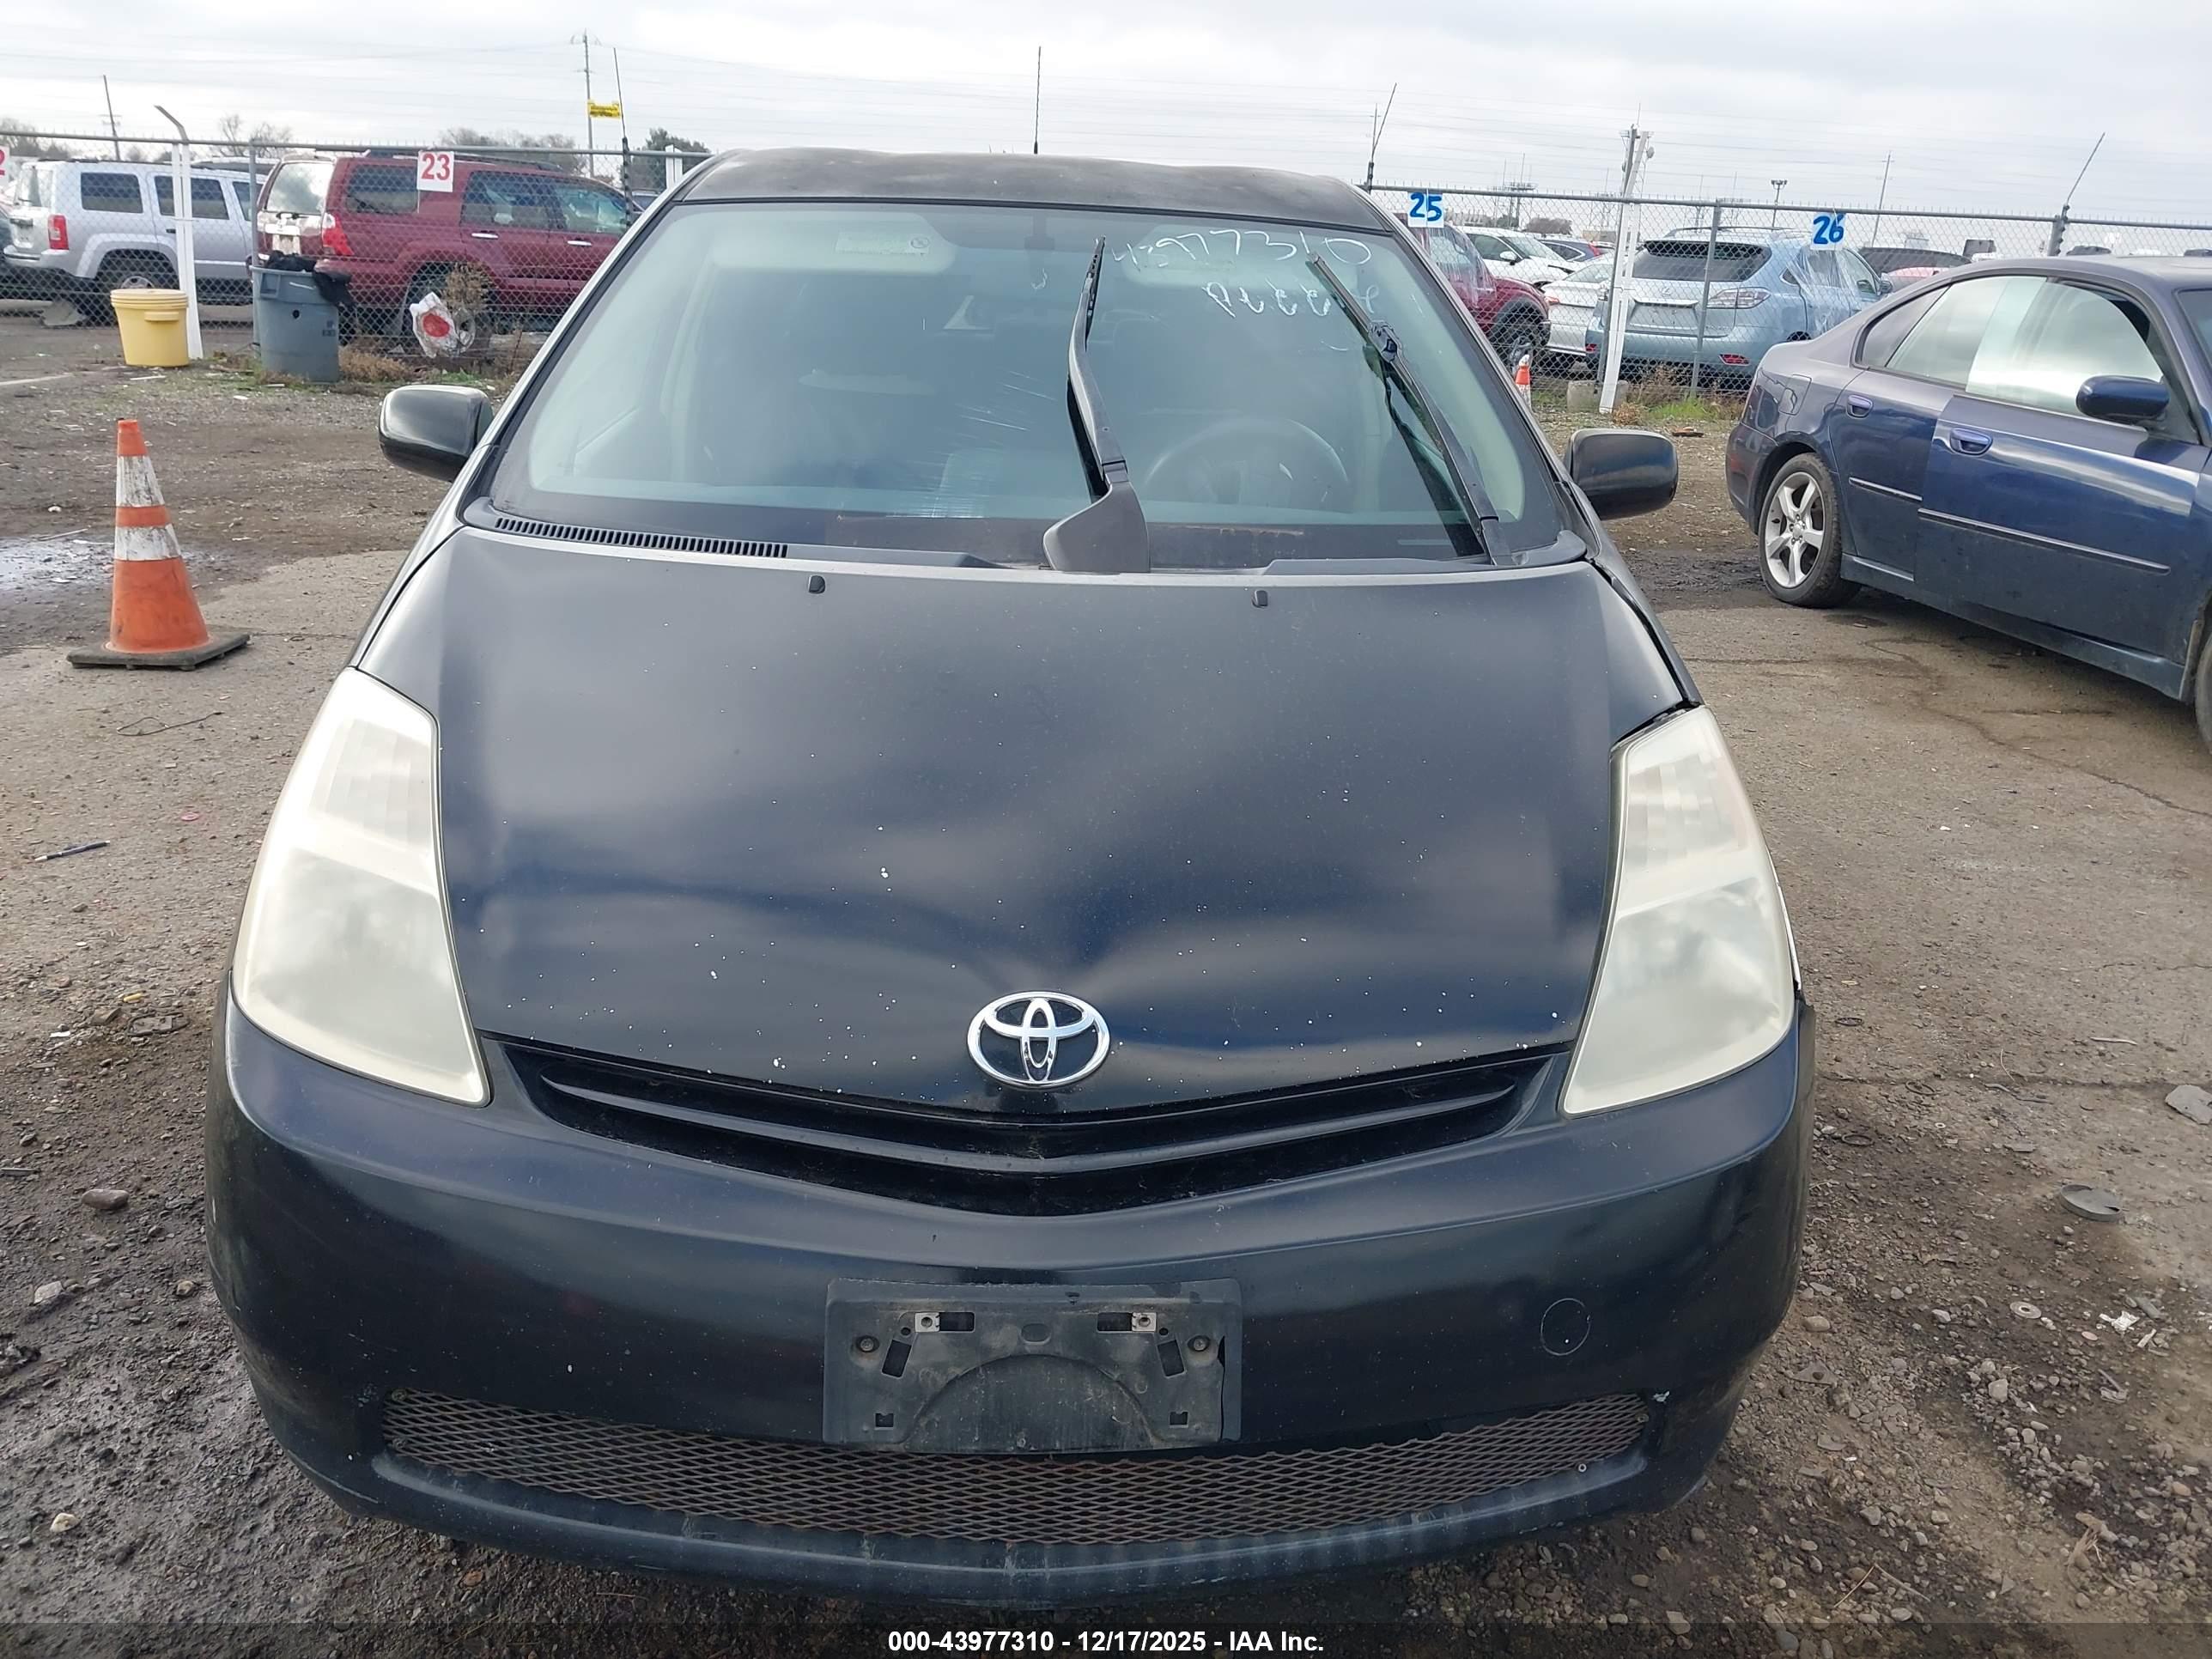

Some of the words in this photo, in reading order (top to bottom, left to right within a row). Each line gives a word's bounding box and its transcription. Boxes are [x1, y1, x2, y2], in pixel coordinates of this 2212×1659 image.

[422, 153, 451, 181] 23
[1409, 191, 1443, 222] 25
[1813, 212, 1845, 245] 26
